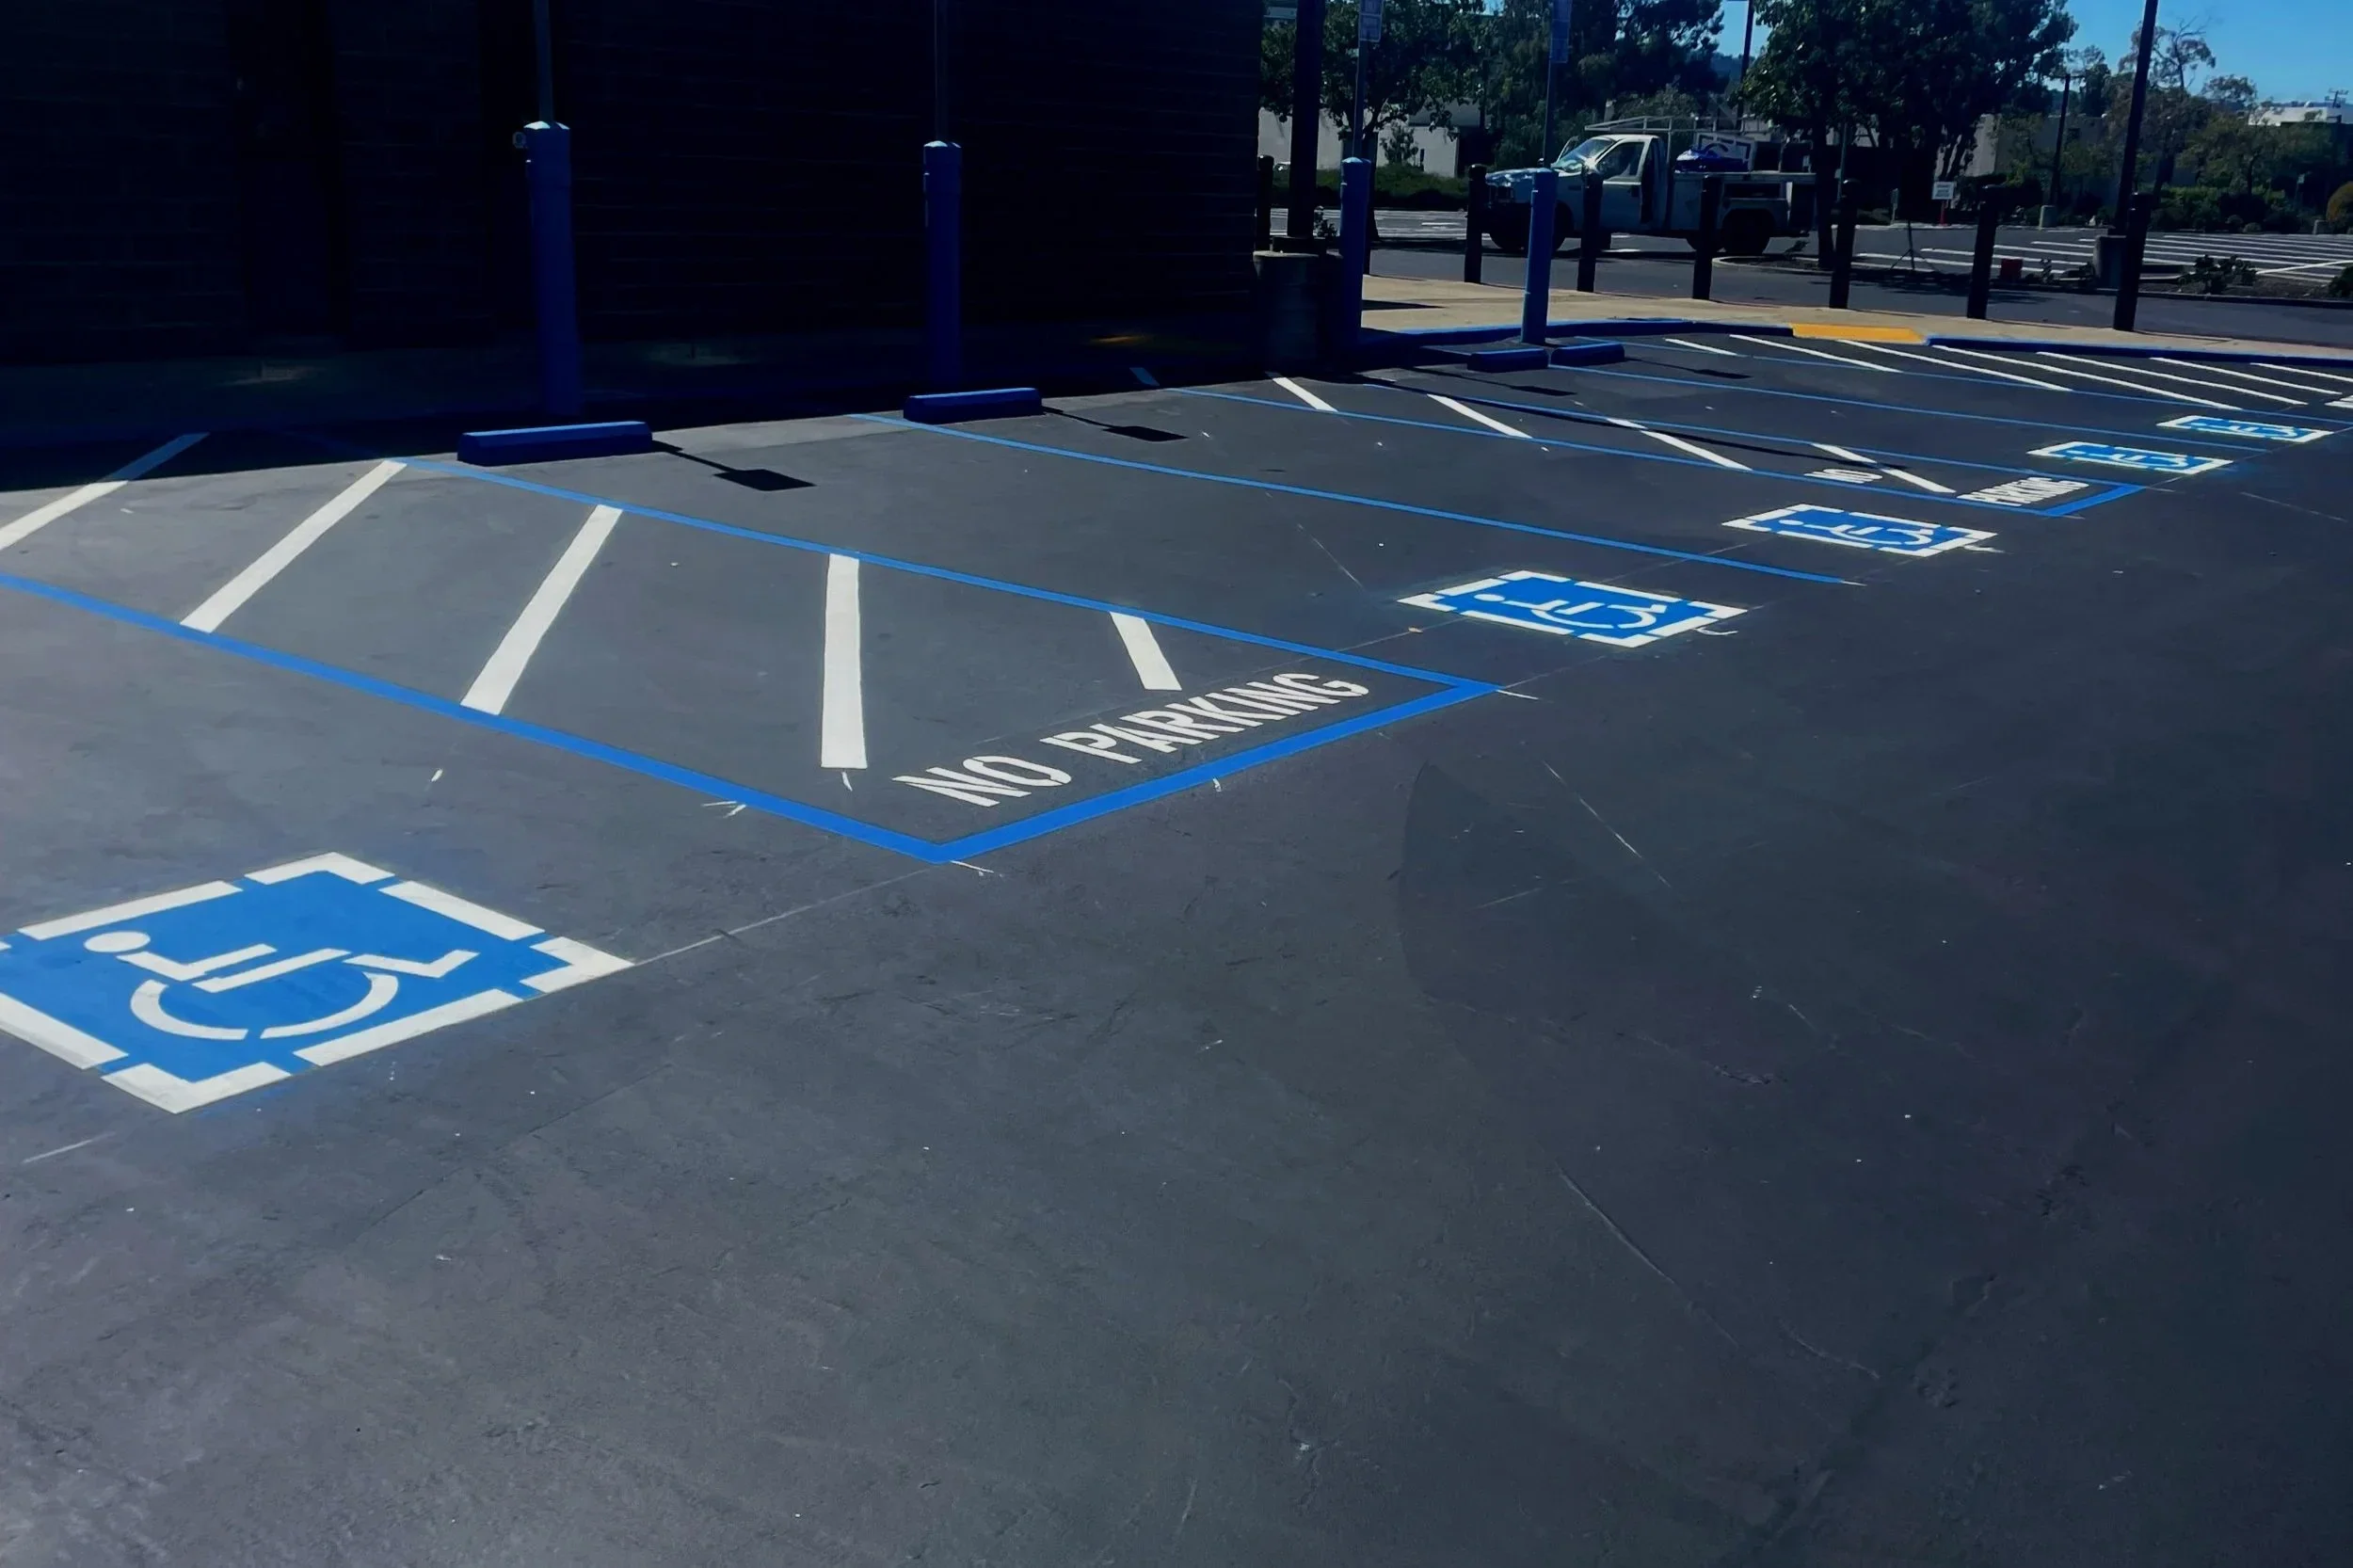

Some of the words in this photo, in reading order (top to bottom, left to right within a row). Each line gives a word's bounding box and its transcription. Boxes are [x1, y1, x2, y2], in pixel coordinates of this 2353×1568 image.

[1803, 469, 1883, 484] NO
[1957, 476, 2089, 506] PARKING
[891, 755, 1072, 808] NO
[1039, 673, 1369, 764] PARKING
